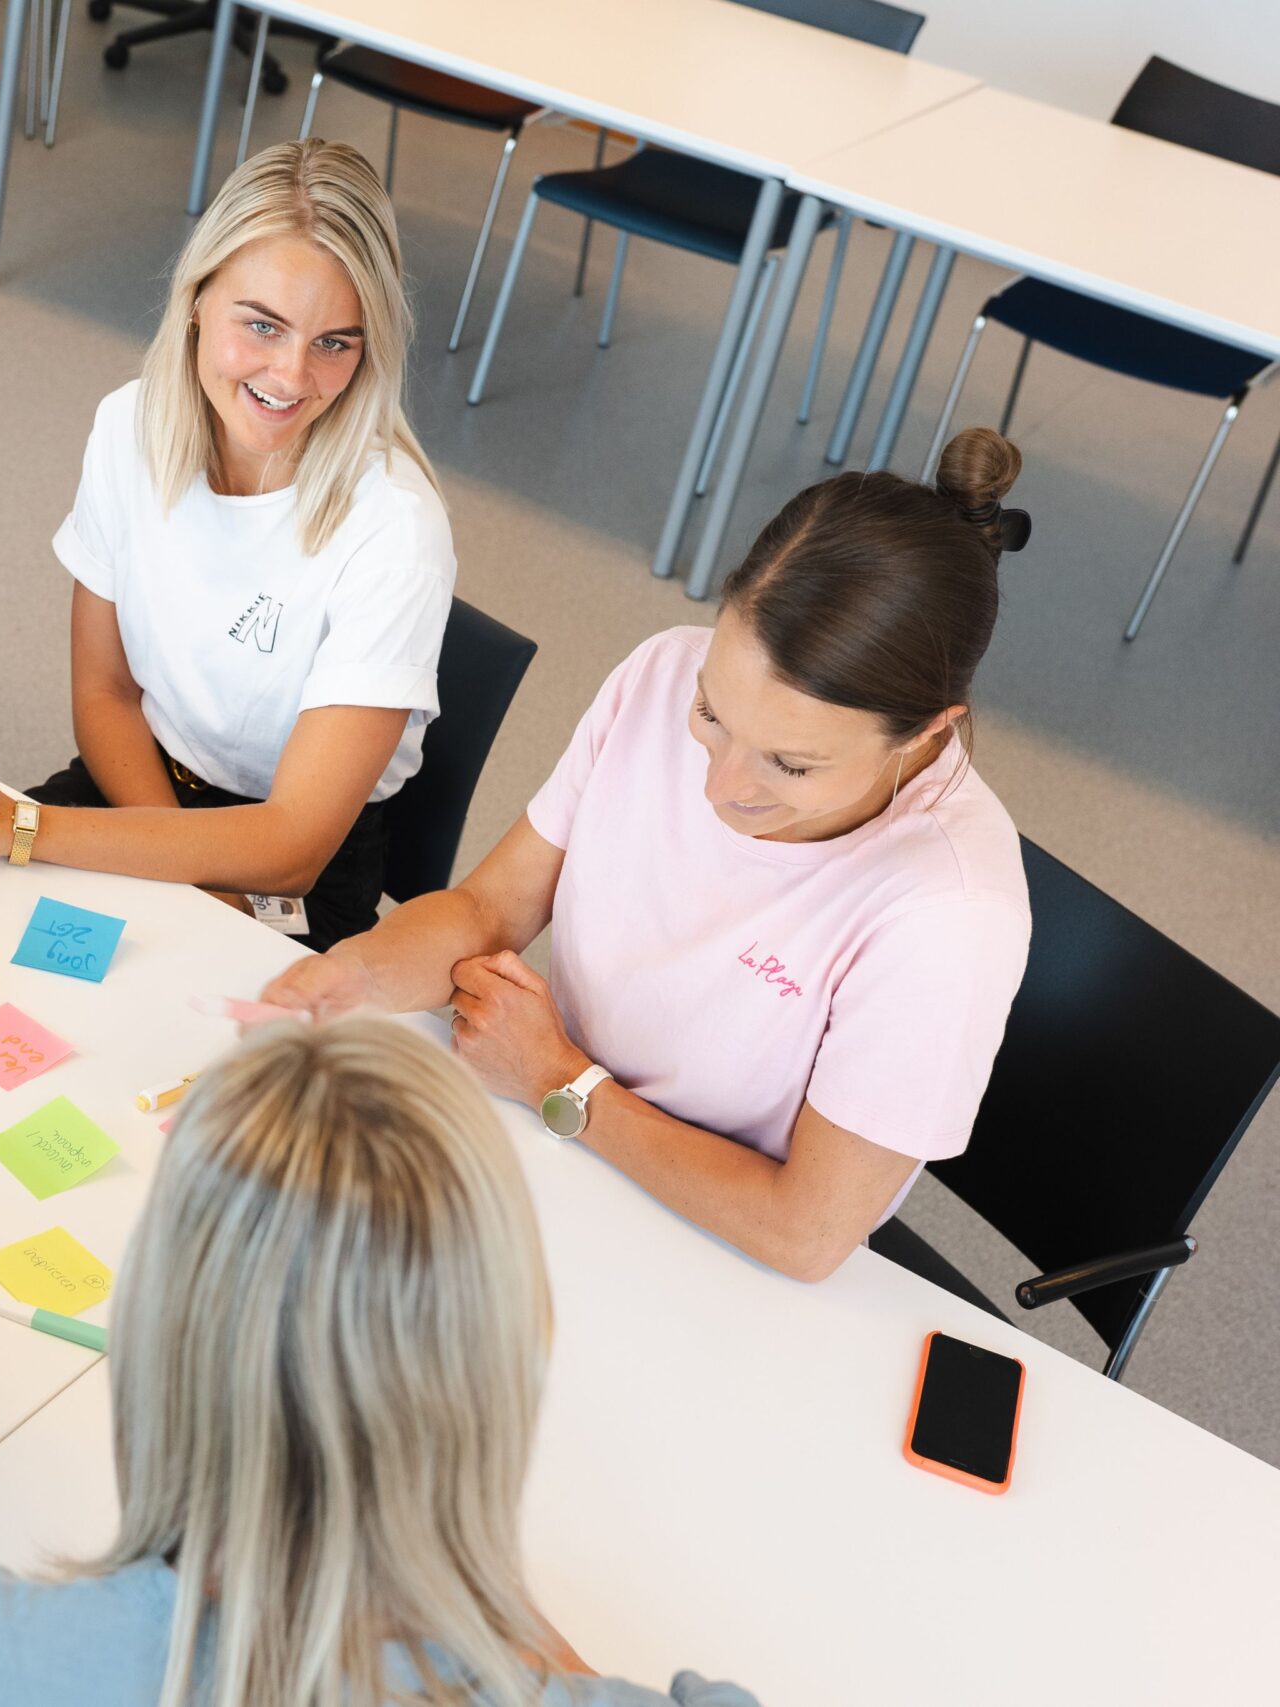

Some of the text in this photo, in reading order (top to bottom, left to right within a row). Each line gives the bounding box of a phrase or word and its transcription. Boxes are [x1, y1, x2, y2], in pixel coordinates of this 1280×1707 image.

[228, 592, 265, 638] NIKKIE
[30, 919, 93, 945] ZGT
[738, 941, 803, 997] La Playa
